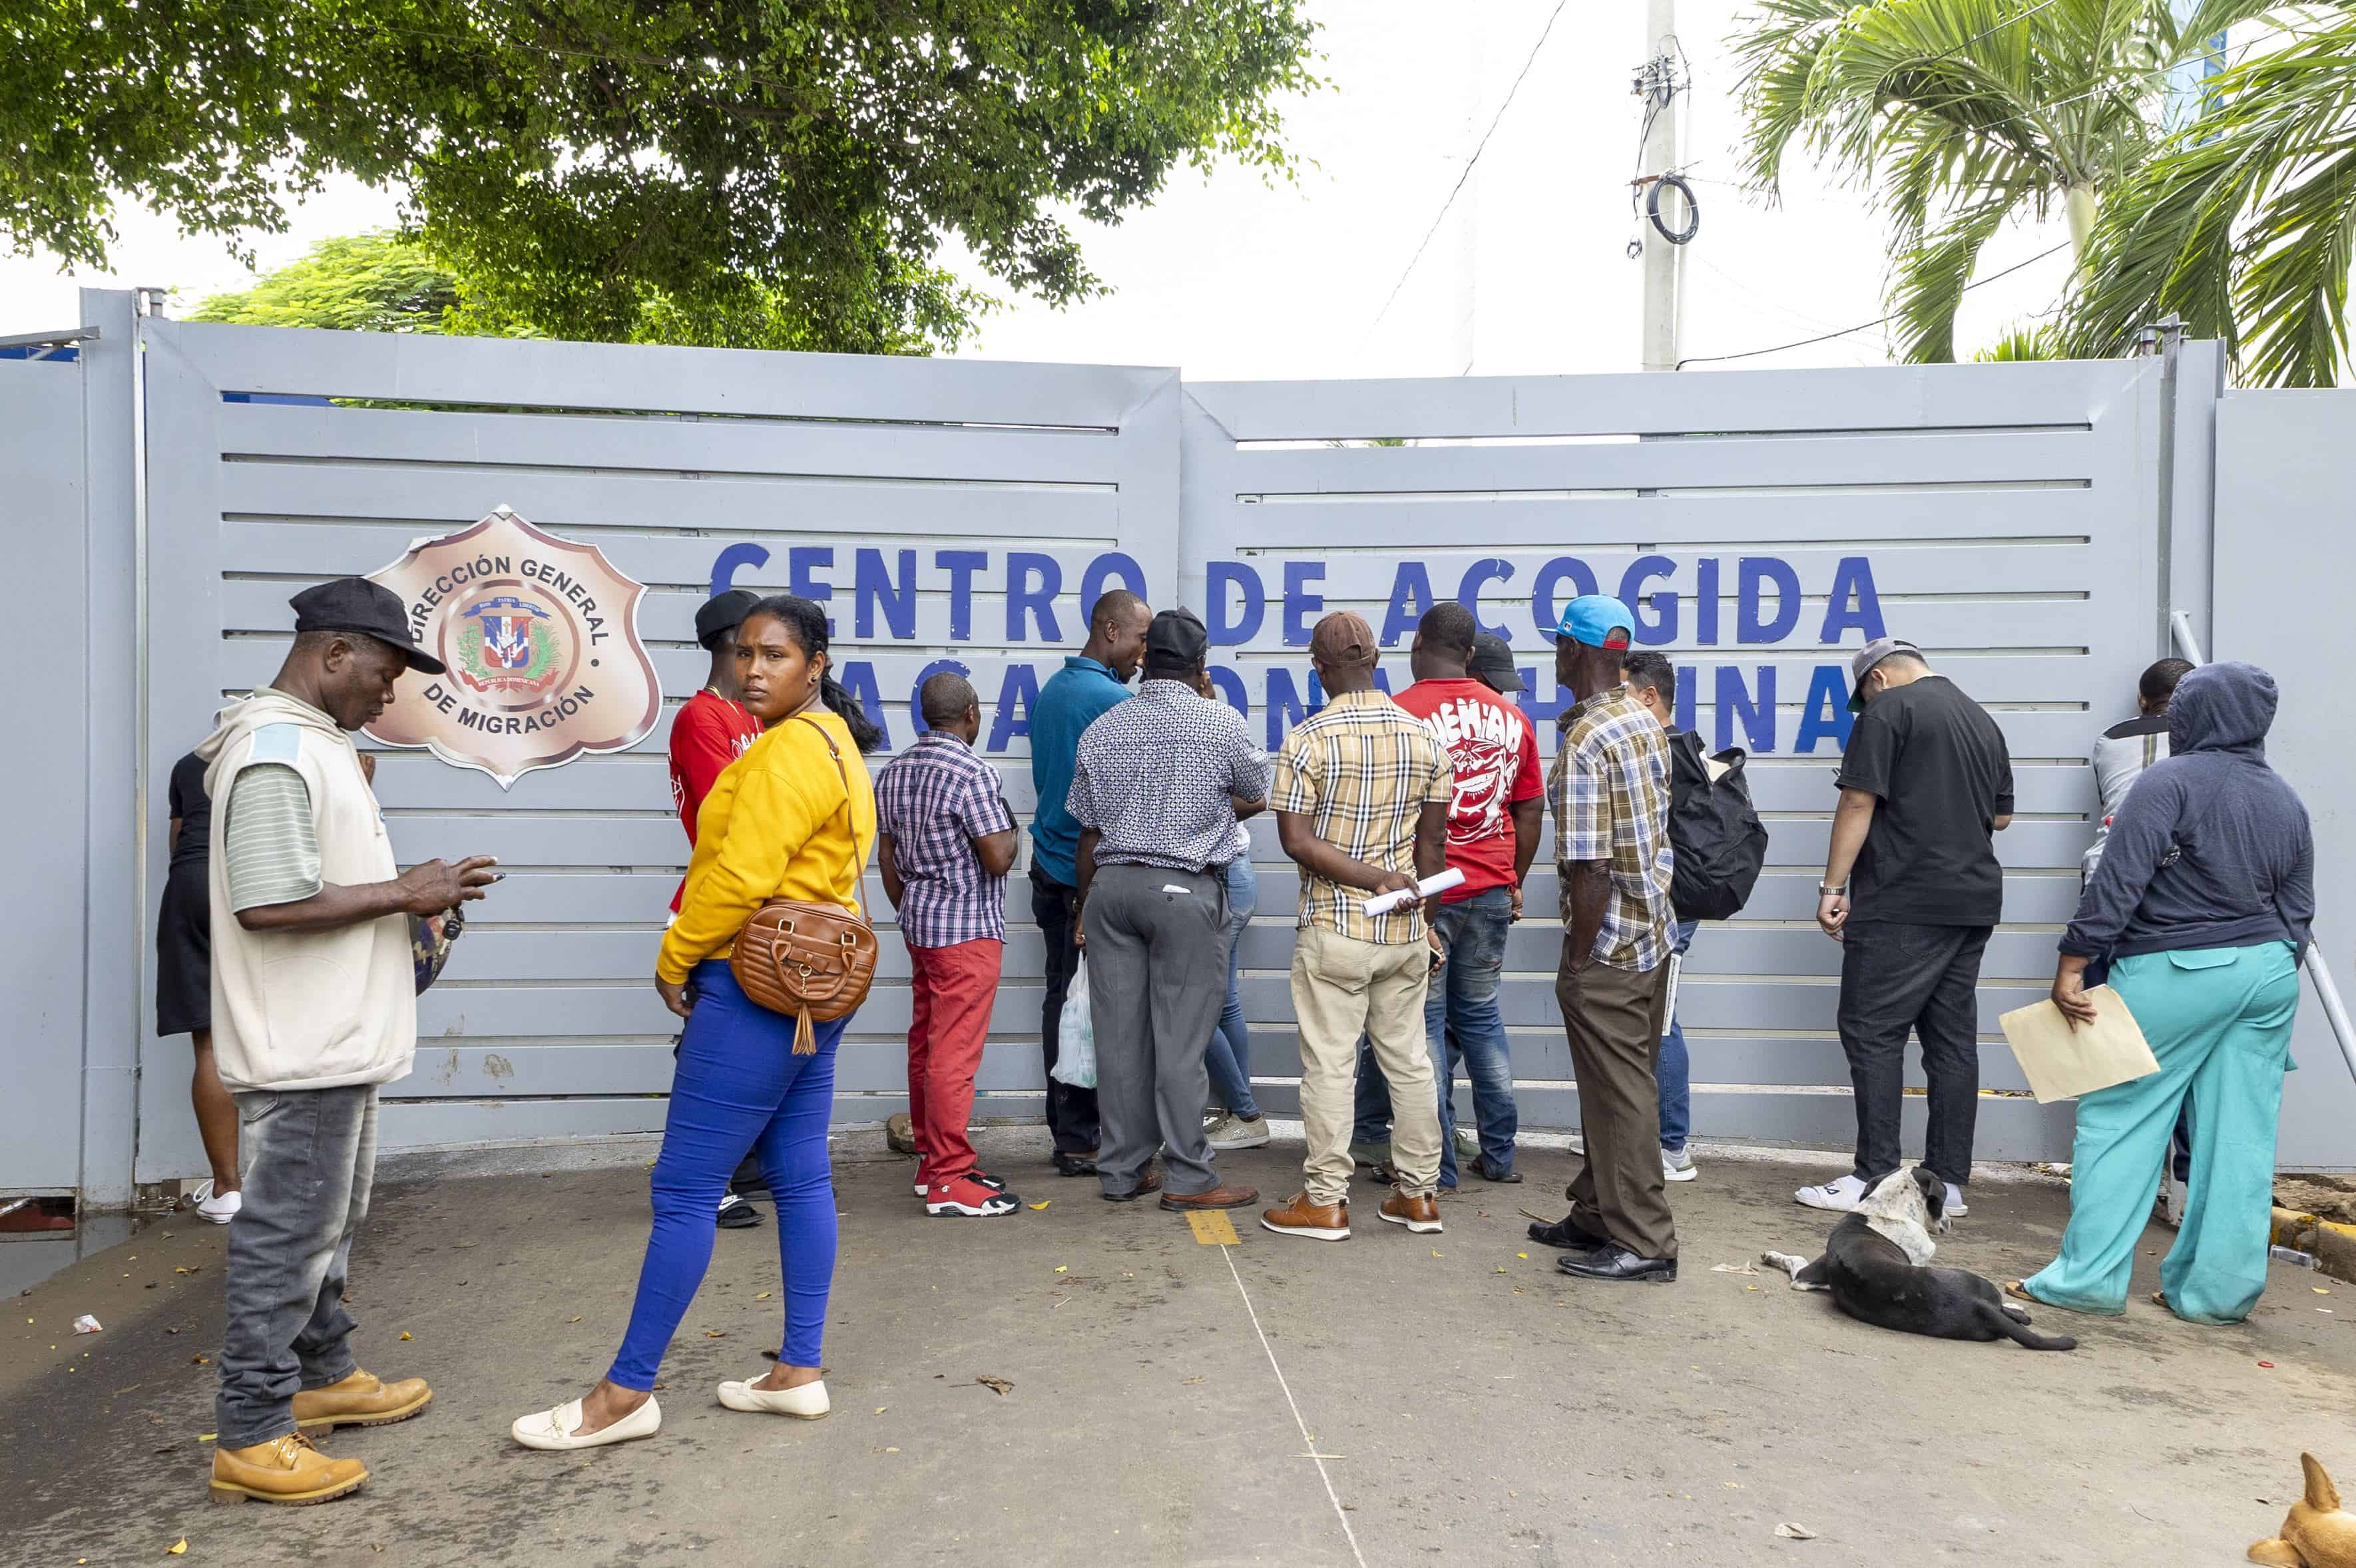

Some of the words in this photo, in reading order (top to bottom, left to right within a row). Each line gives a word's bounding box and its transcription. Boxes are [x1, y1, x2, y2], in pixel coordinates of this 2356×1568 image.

[411, 554, 511, 644] DIRECCIÓN
[521, 559, 608, 646] GENERAL
[710, 542, 1146, 642] CENTRO
[1206, 561, 1325, 646] DE
[1379, 556, 1887, 646] ACOGIDA
[423, 683, 457, 714] DE
[457, 685, 595, 735] MIGRACIÓN
[1517, 666, 1855, 753] HINA
